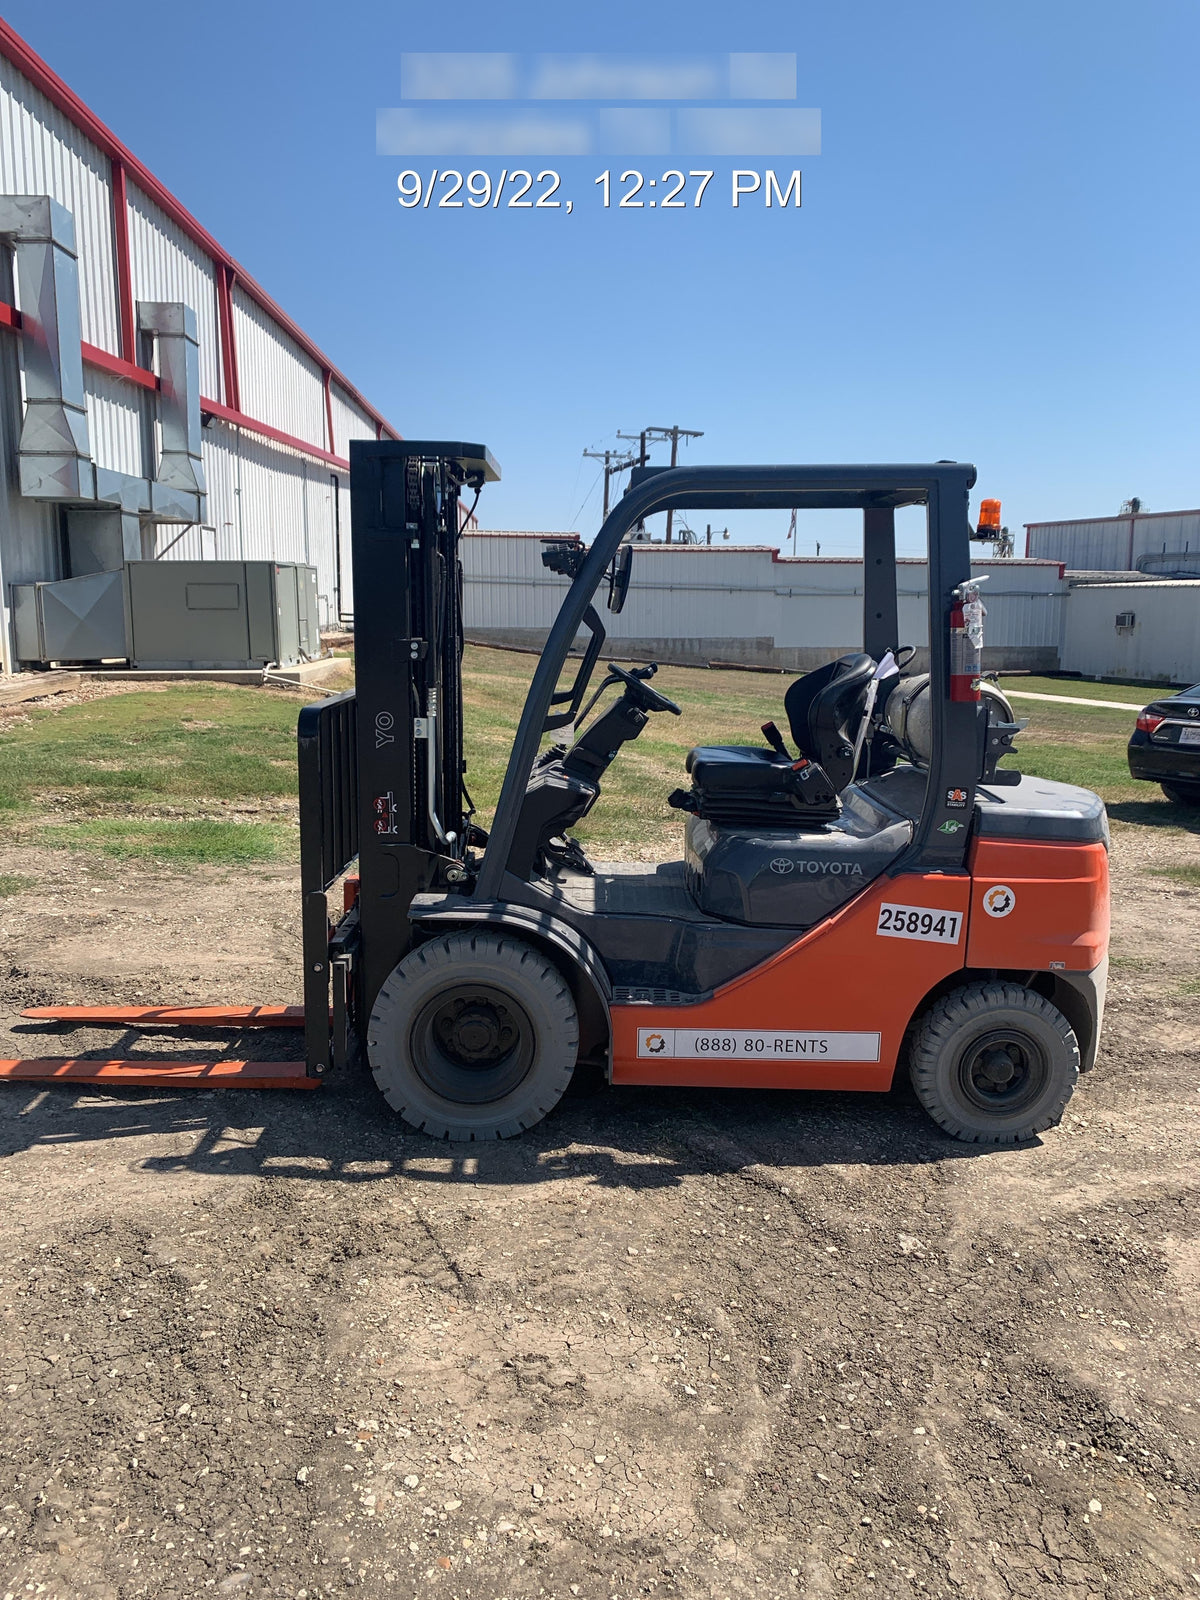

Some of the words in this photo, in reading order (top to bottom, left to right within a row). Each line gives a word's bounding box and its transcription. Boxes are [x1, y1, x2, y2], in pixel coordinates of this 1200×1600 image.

[375, 711, 395, 749] YO
[947, 788, 967, 802] SAS
[797, 860, 863, 876] TOYOTA
[878, 908, 957, 938] 258941
[694, 1037, 737, 1054] (888)
[744, 1038, 828, 1054] 80-RENTS
